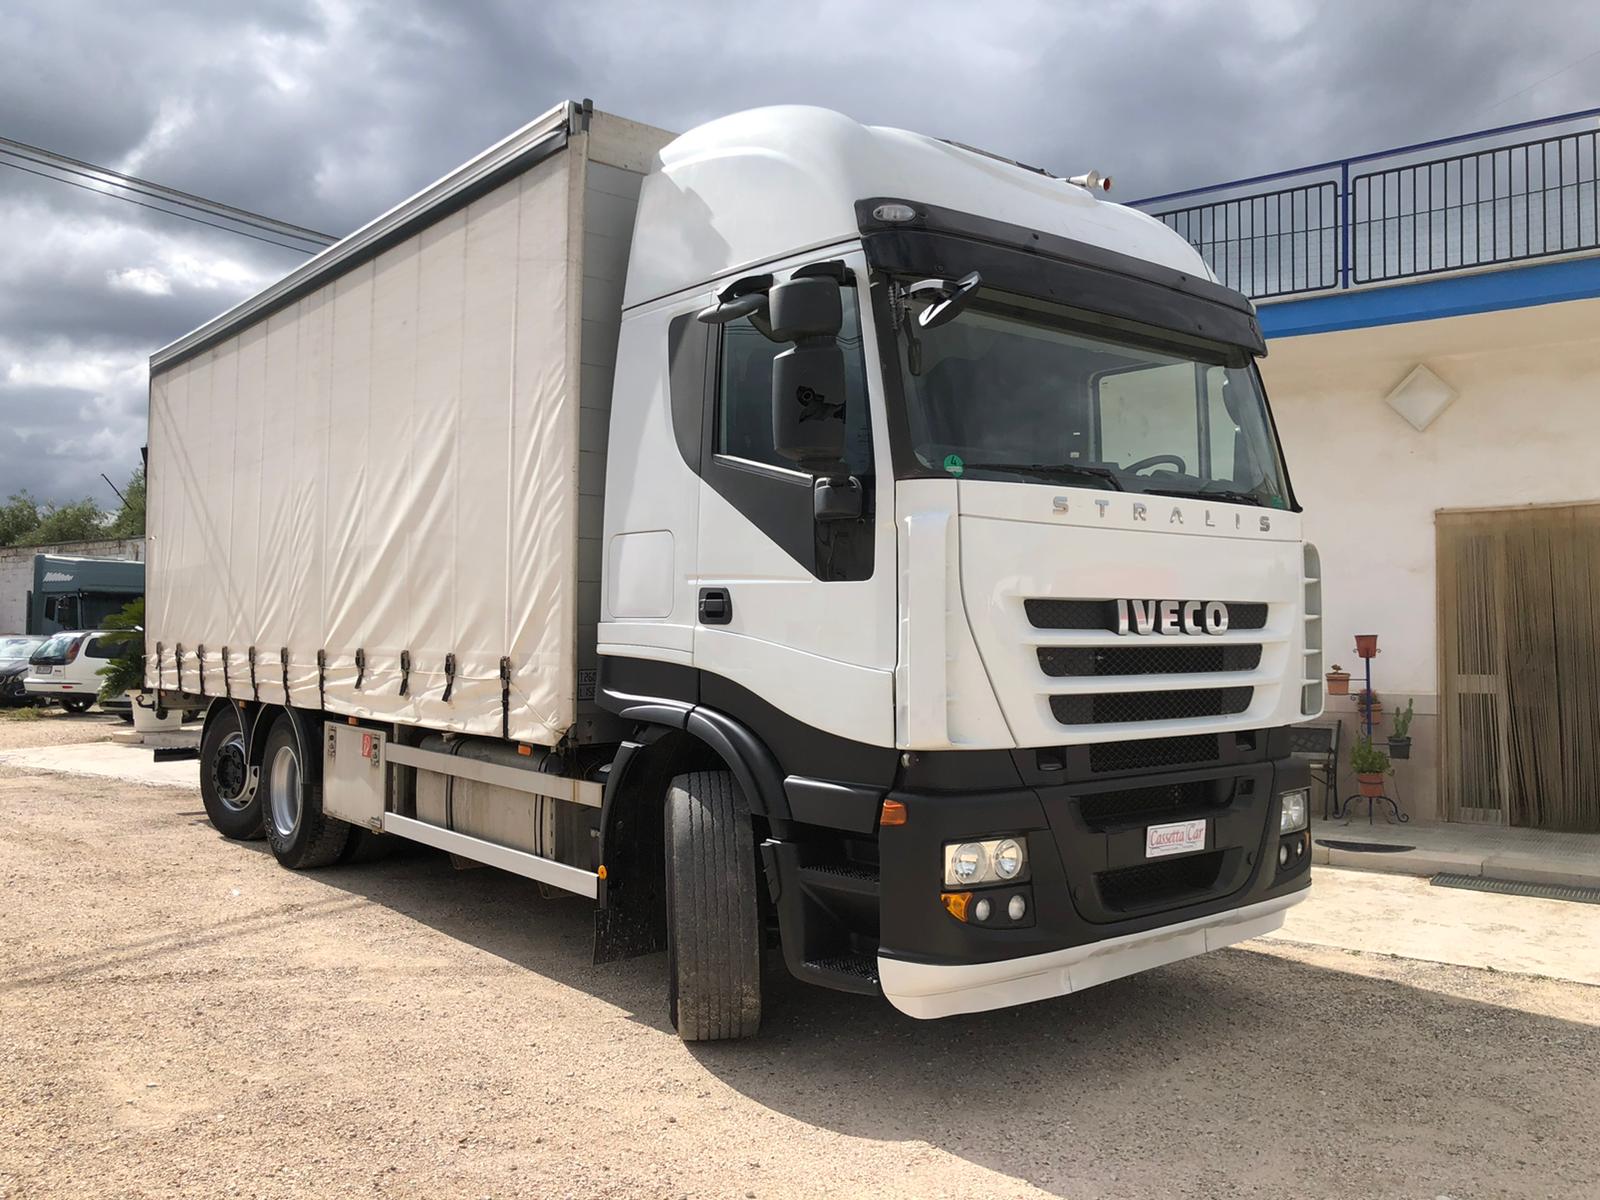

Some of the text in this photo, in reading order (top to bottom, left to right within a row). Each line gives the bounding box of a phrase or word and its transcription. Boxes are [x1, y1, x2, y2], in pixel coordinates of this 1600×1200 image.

[1052, 496, 1271, 532] STRALIS
[1117, 599, 1229, 636] IVECO
[1150, 823, 1204, 846] Cassetta Car
